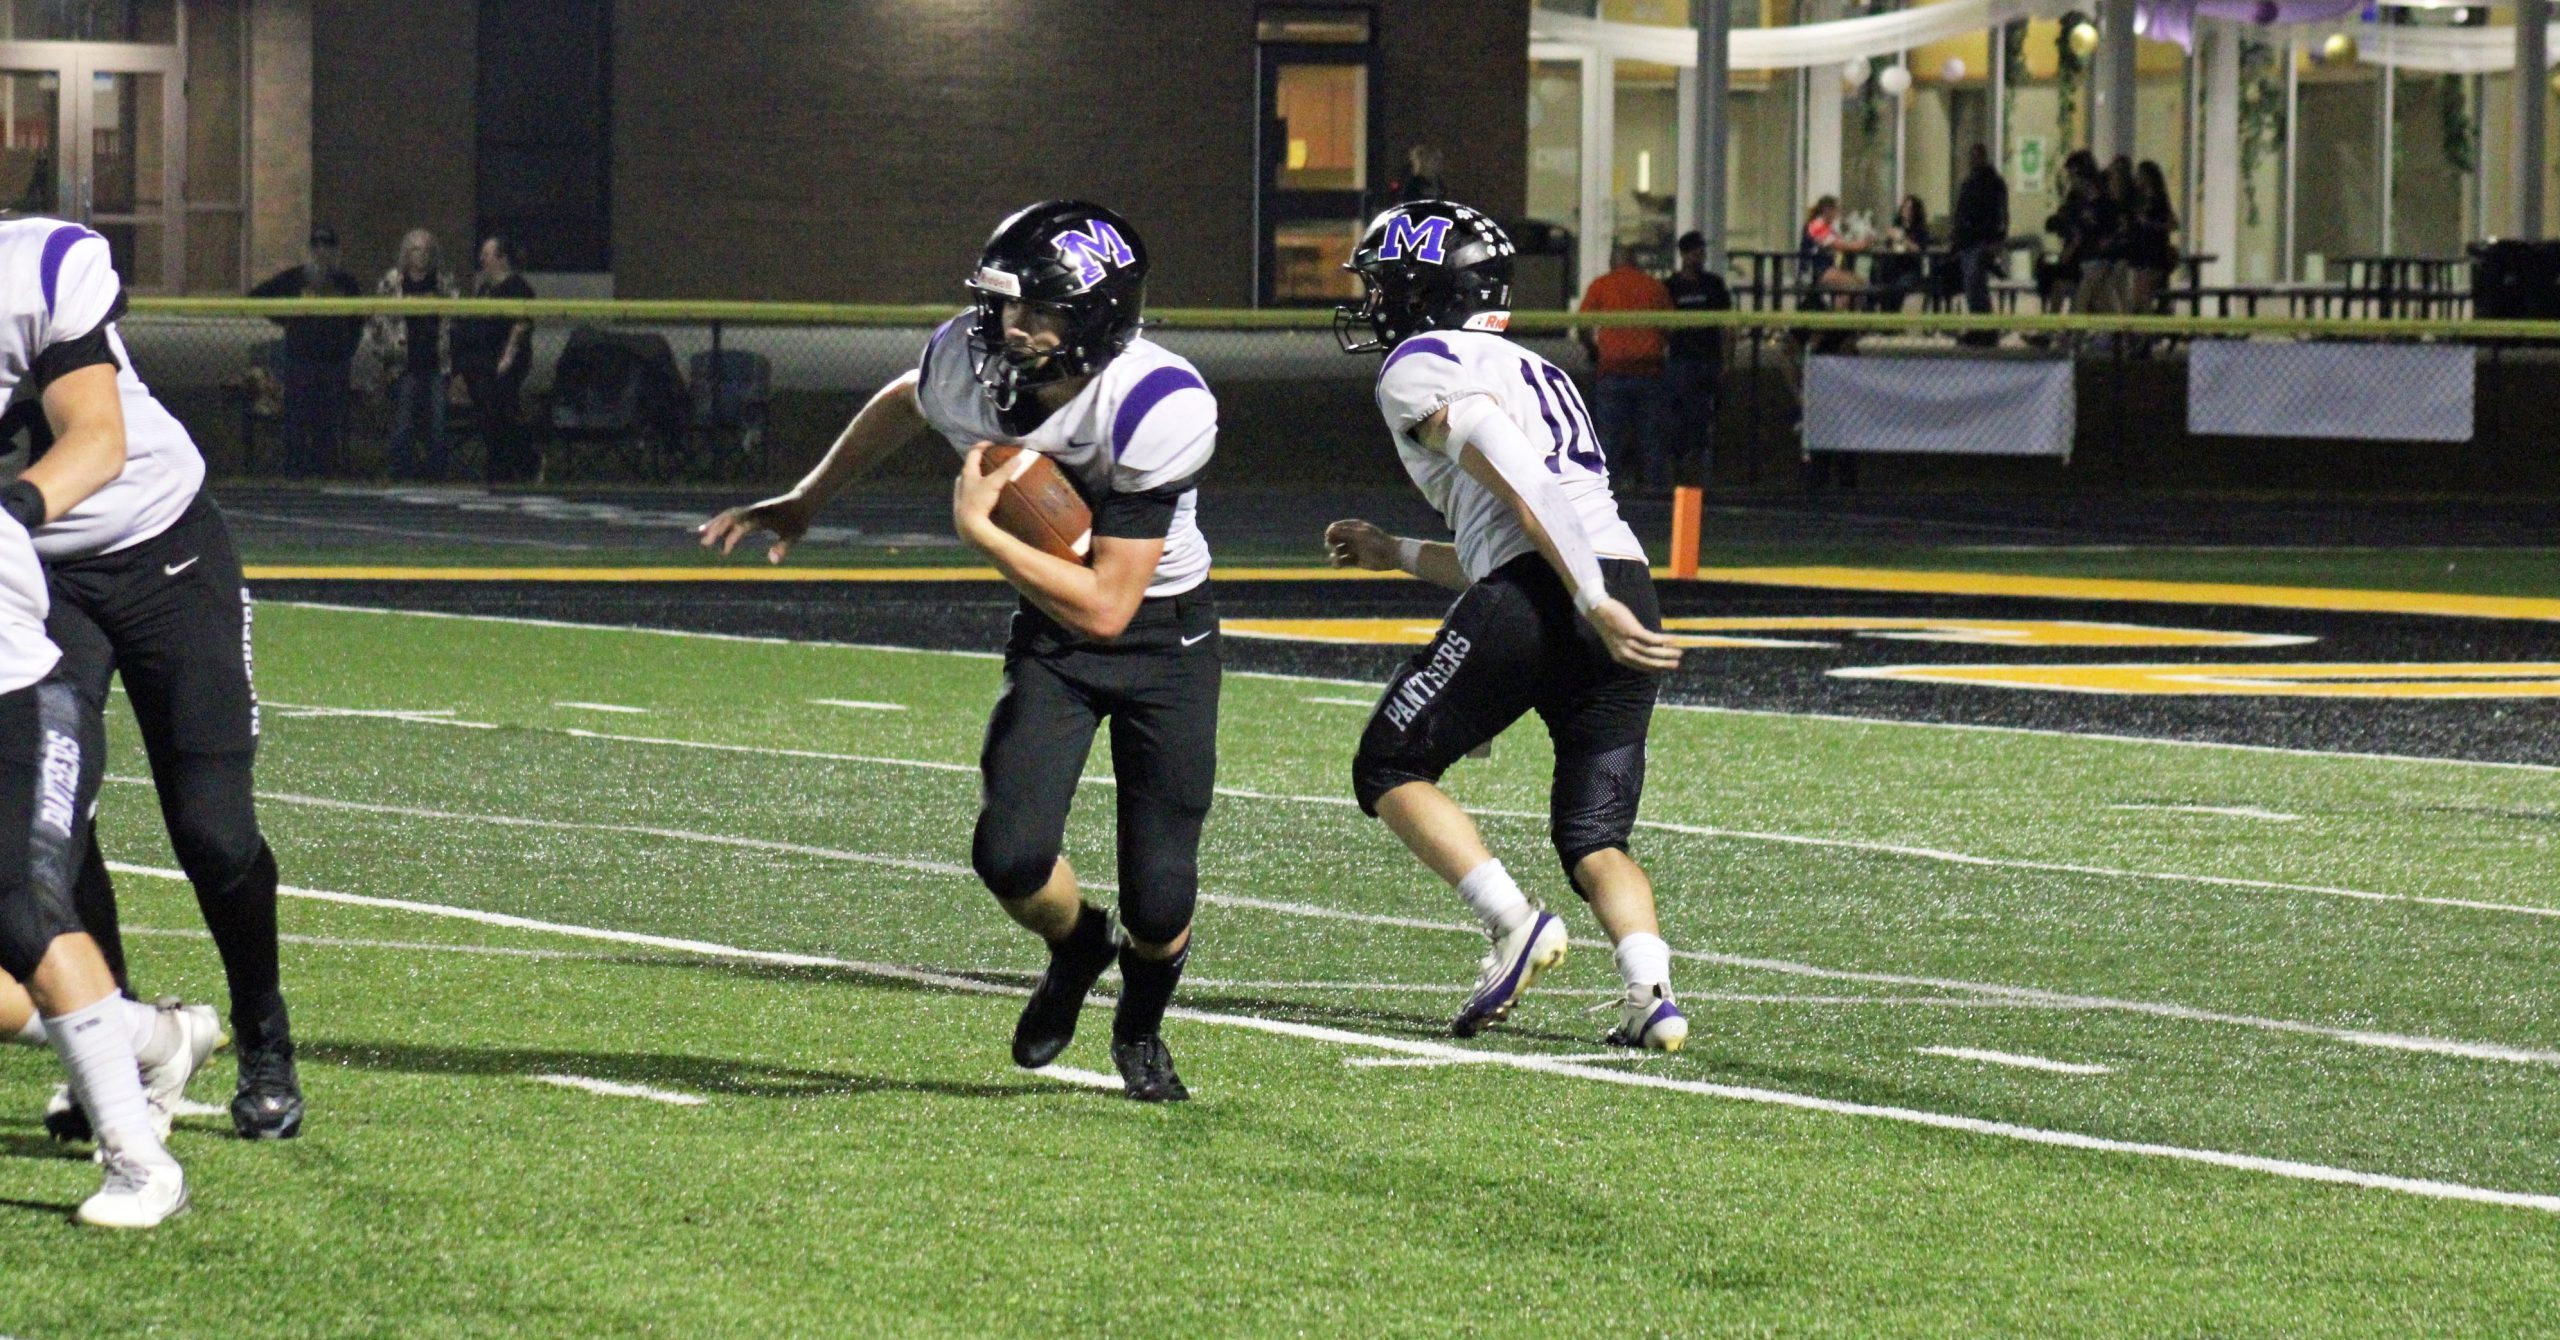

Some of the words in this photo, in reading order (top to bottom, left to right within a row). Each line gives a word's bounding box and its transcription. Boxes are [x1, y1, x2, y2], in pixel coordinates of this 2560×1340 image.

[1051, 219, 1136, 290] M
[1378, 214, 1453, 265] M
[1520, 357, 1604, 474] 10
[1384, 631, 1471, 732] PANTHERS
